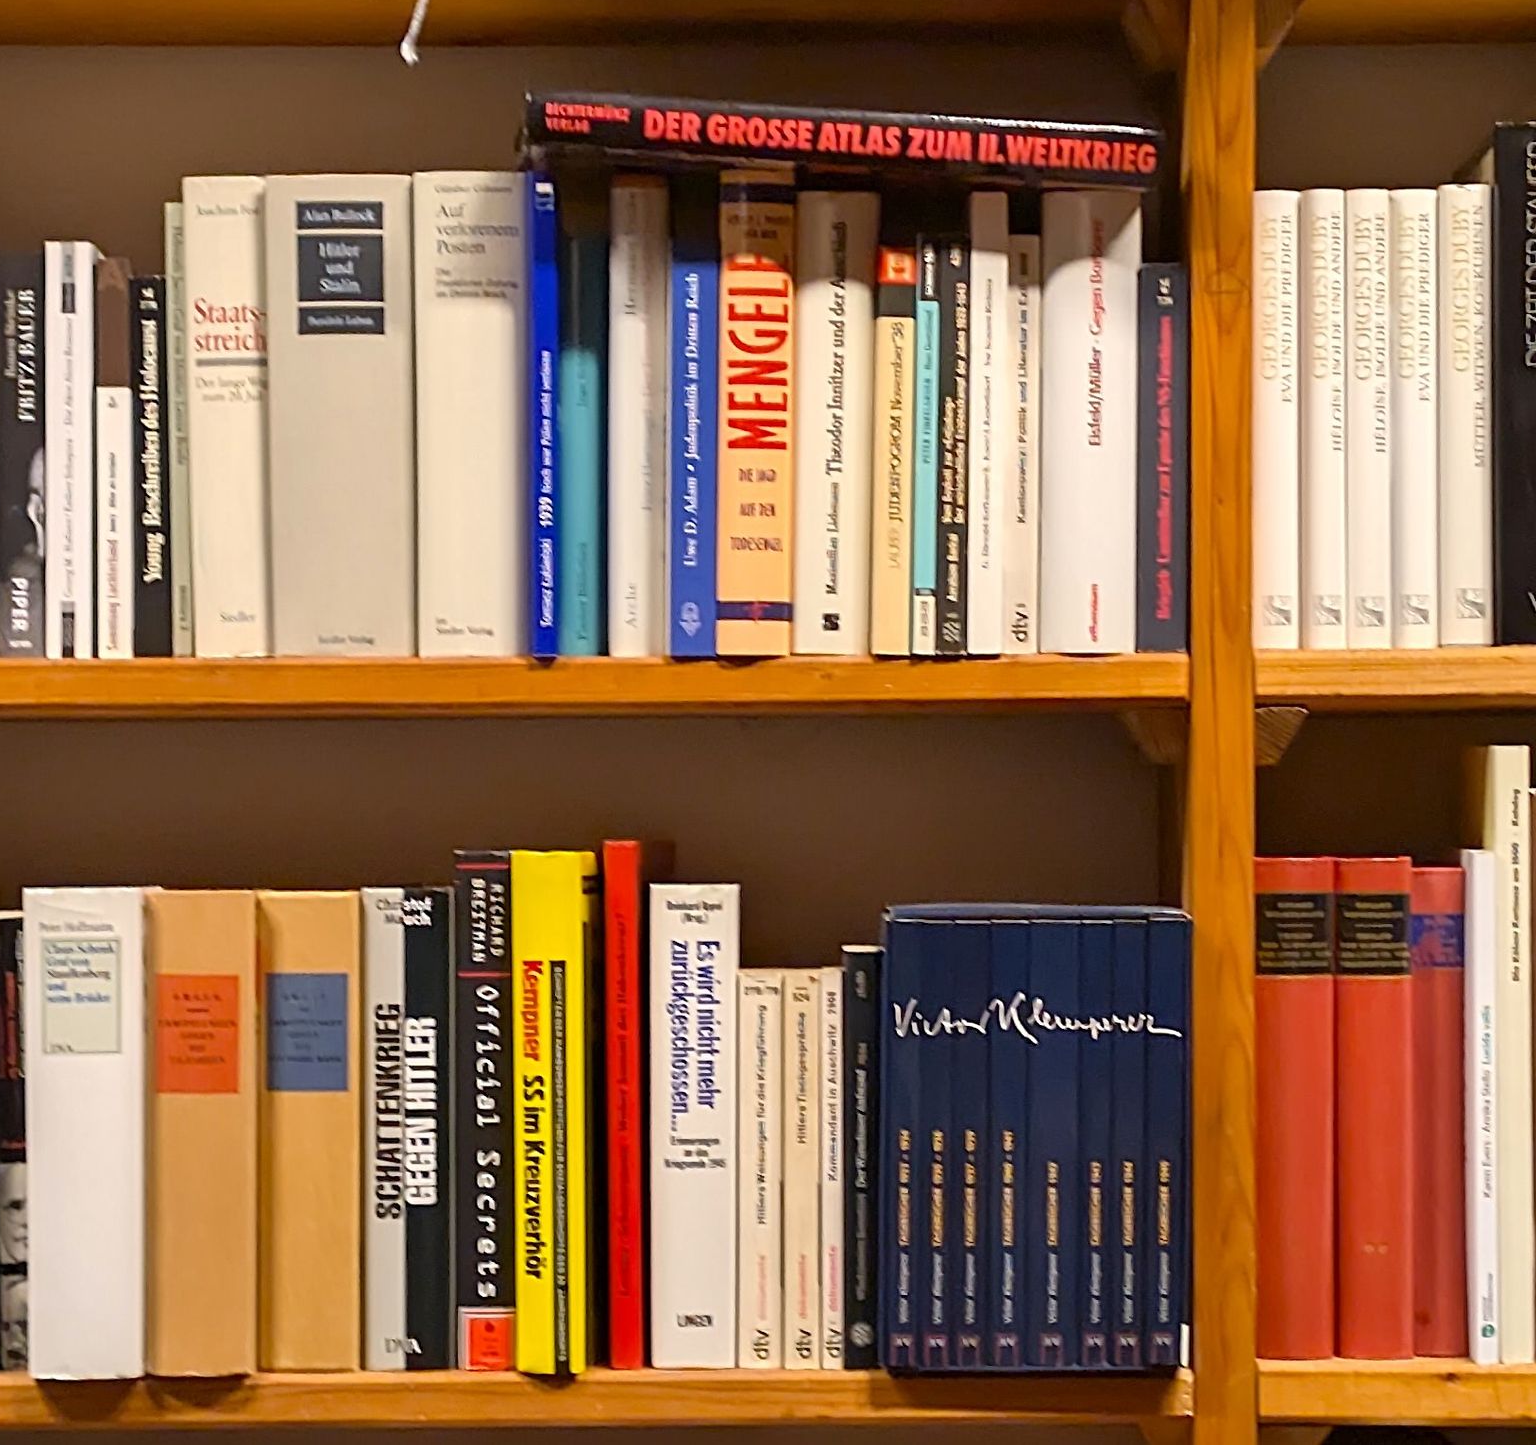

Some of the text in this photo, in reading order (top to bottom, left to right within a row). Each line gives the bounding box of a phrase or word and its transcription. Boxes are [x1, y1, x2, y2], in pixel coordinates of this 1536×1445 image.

[643, 107, 702, 144] DER
[707, 111, 812, 152] GROSSE
[816, 118, 901, 158] ATLAS
[905, 126, 974, 163] ZUM
[1007, 133, 1158, 174] WELTKRIEG
[375, 1003, 402, 1220] SCHATTENKRIEG
[404, 1017, 437, 1206] GEGEN HITLER
[696, 940, 720, 1109] Es wird nicht mehr
[520, 959, 546, 1279] Kempner SS im Kreuzverhör
[749, 1329, 772, 1360] dtv
